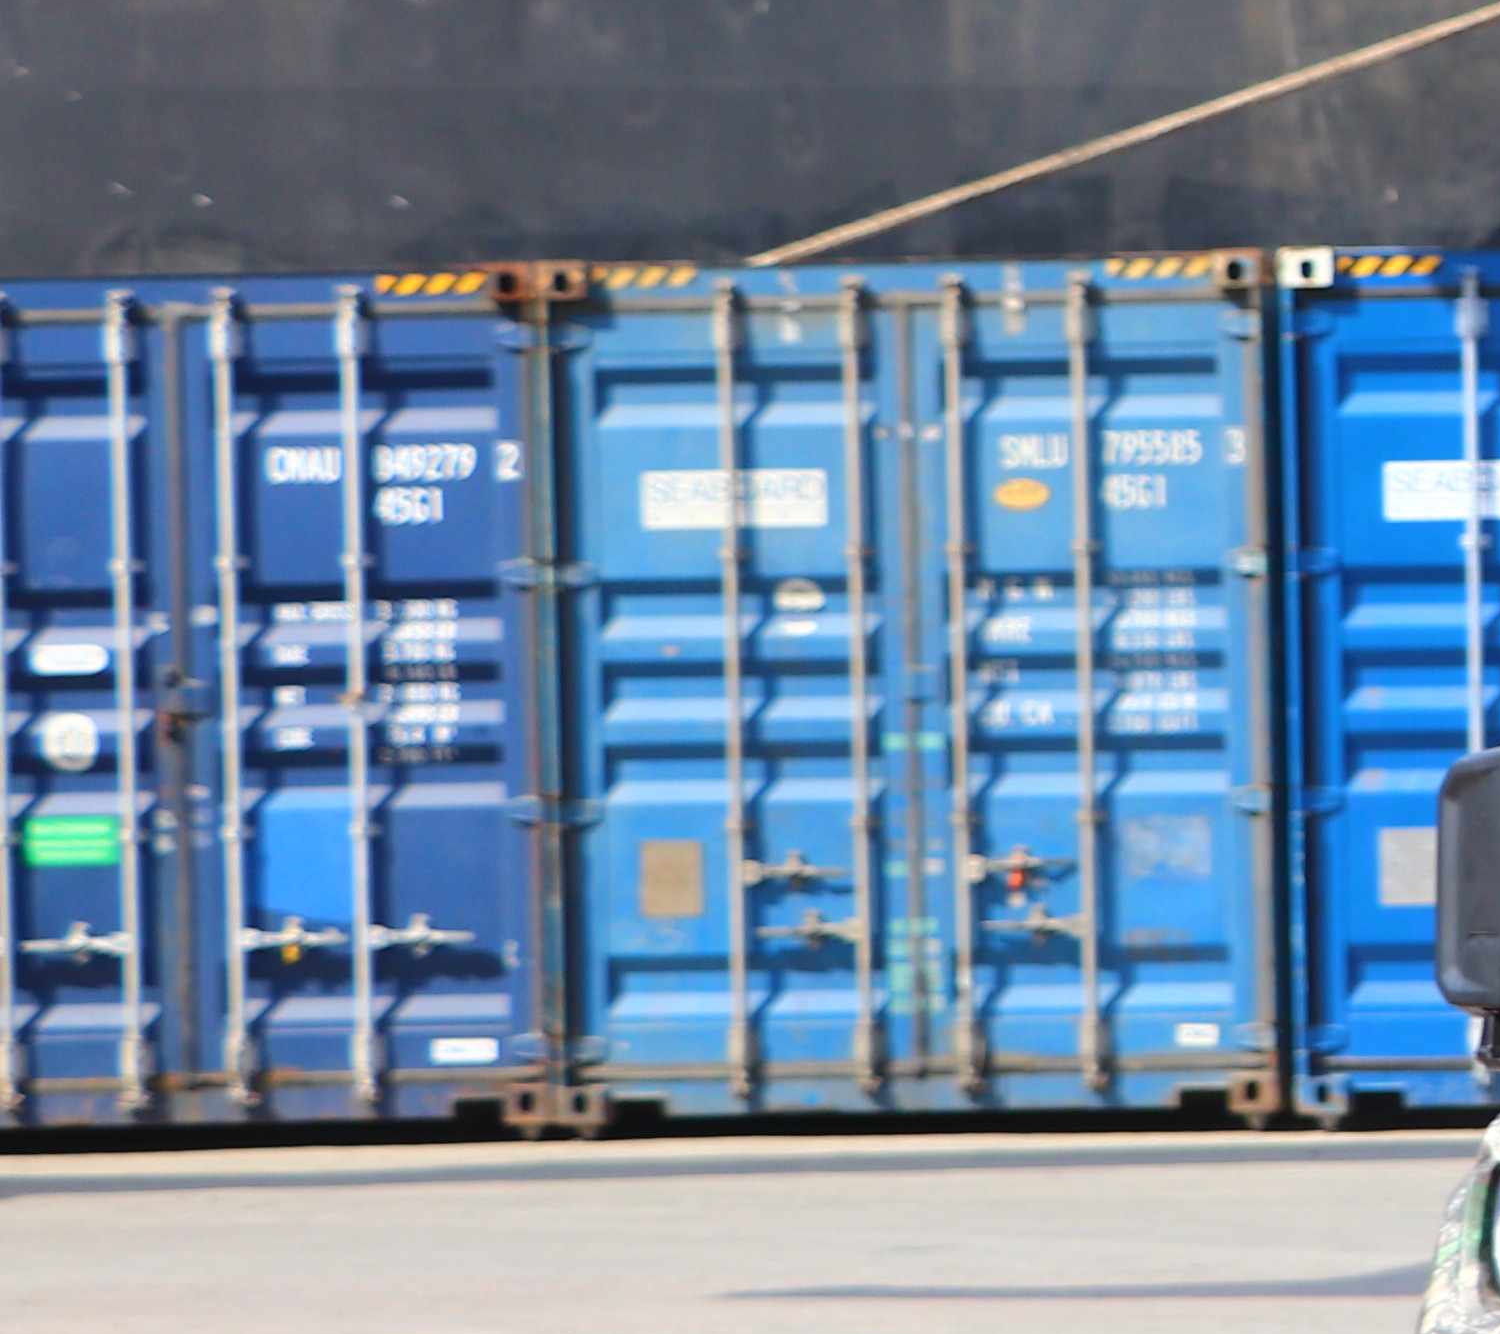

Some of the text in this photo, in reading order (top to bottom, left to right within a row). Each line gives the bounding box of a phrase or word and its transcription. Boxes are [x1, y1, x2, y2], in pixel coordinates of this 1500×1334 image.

[495, 440, 523, 481] 2
[999, 433, 1069, 469] SMLU
[1224, 427, 1247, 464] 3
